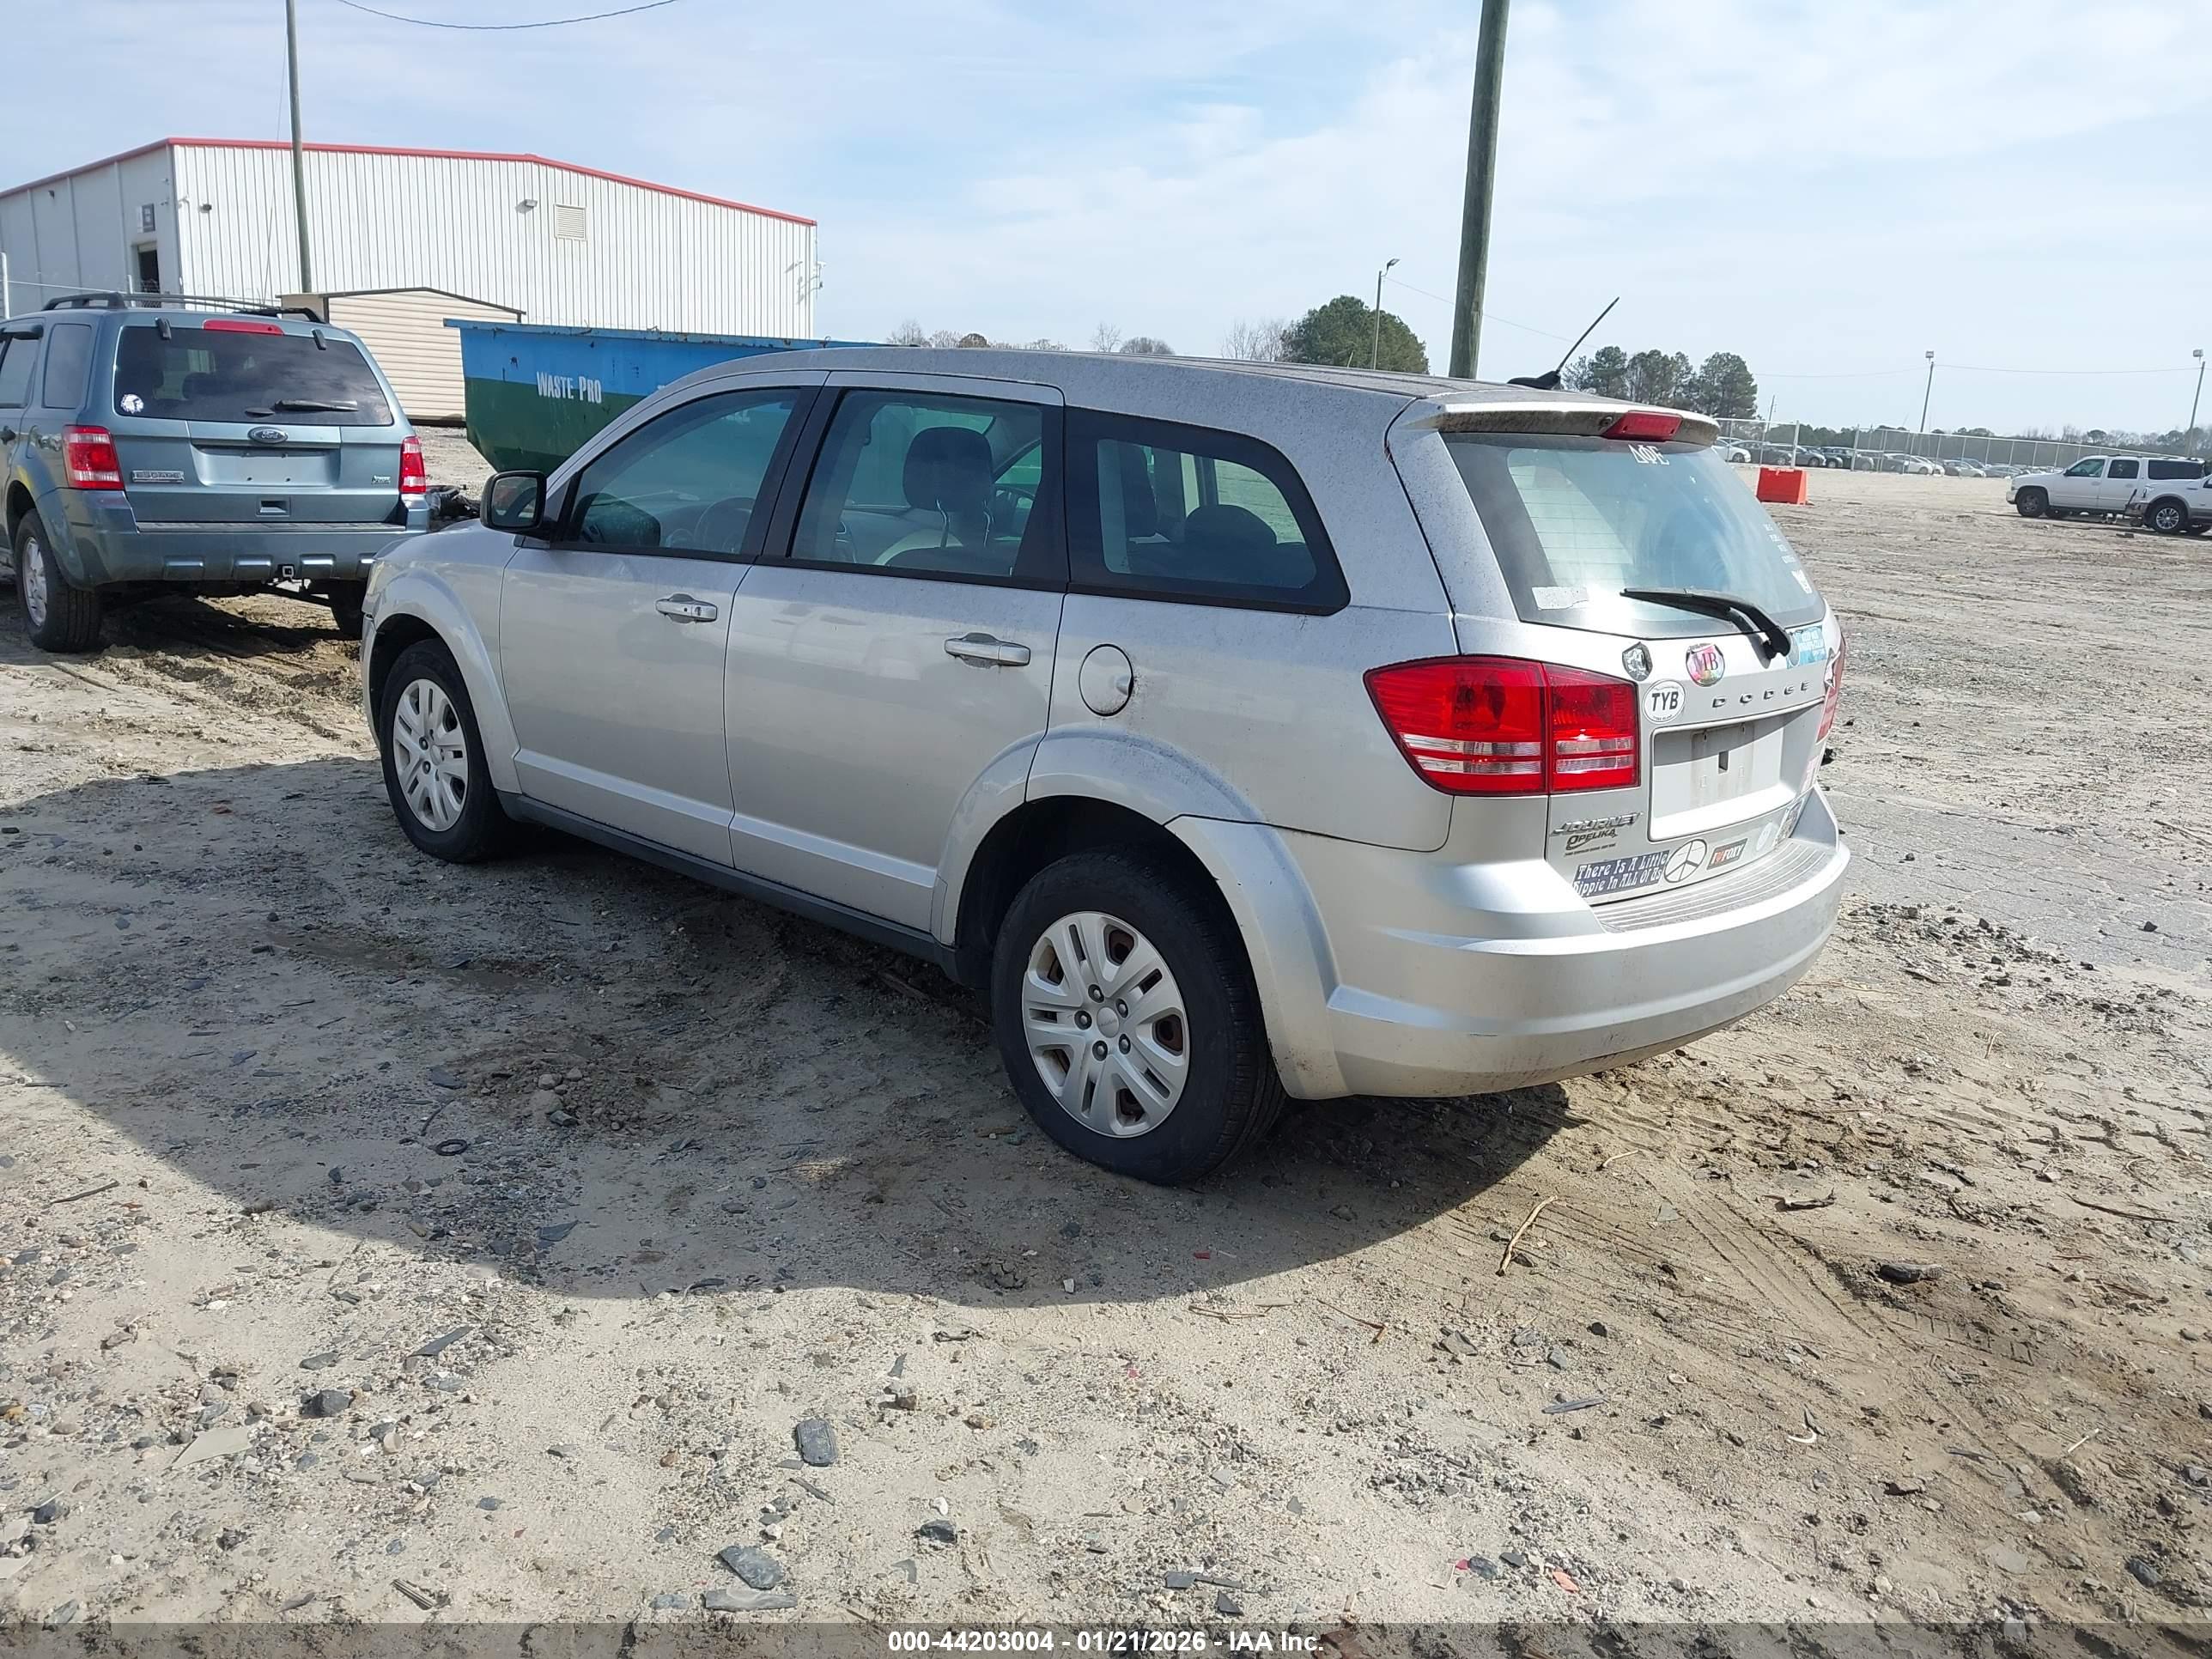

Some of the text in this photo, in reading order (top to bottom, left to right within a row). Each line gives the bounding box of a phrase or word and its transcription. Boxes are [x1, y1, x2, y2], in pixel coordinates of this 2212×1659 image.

[536, 370, 602, 404] WASTE PRO
[1651, 690, 1680, 712] TYB
[1711, 681, 1809, 708] DODGE
[1551, 812, 1643, 836] JOURNEY
[1577, 864, 1612, 880] There
[1613, 860, 1626, 874] Is
[1638, 852, 1668, 871] Little
[1607, 875, 1618, 890] In
